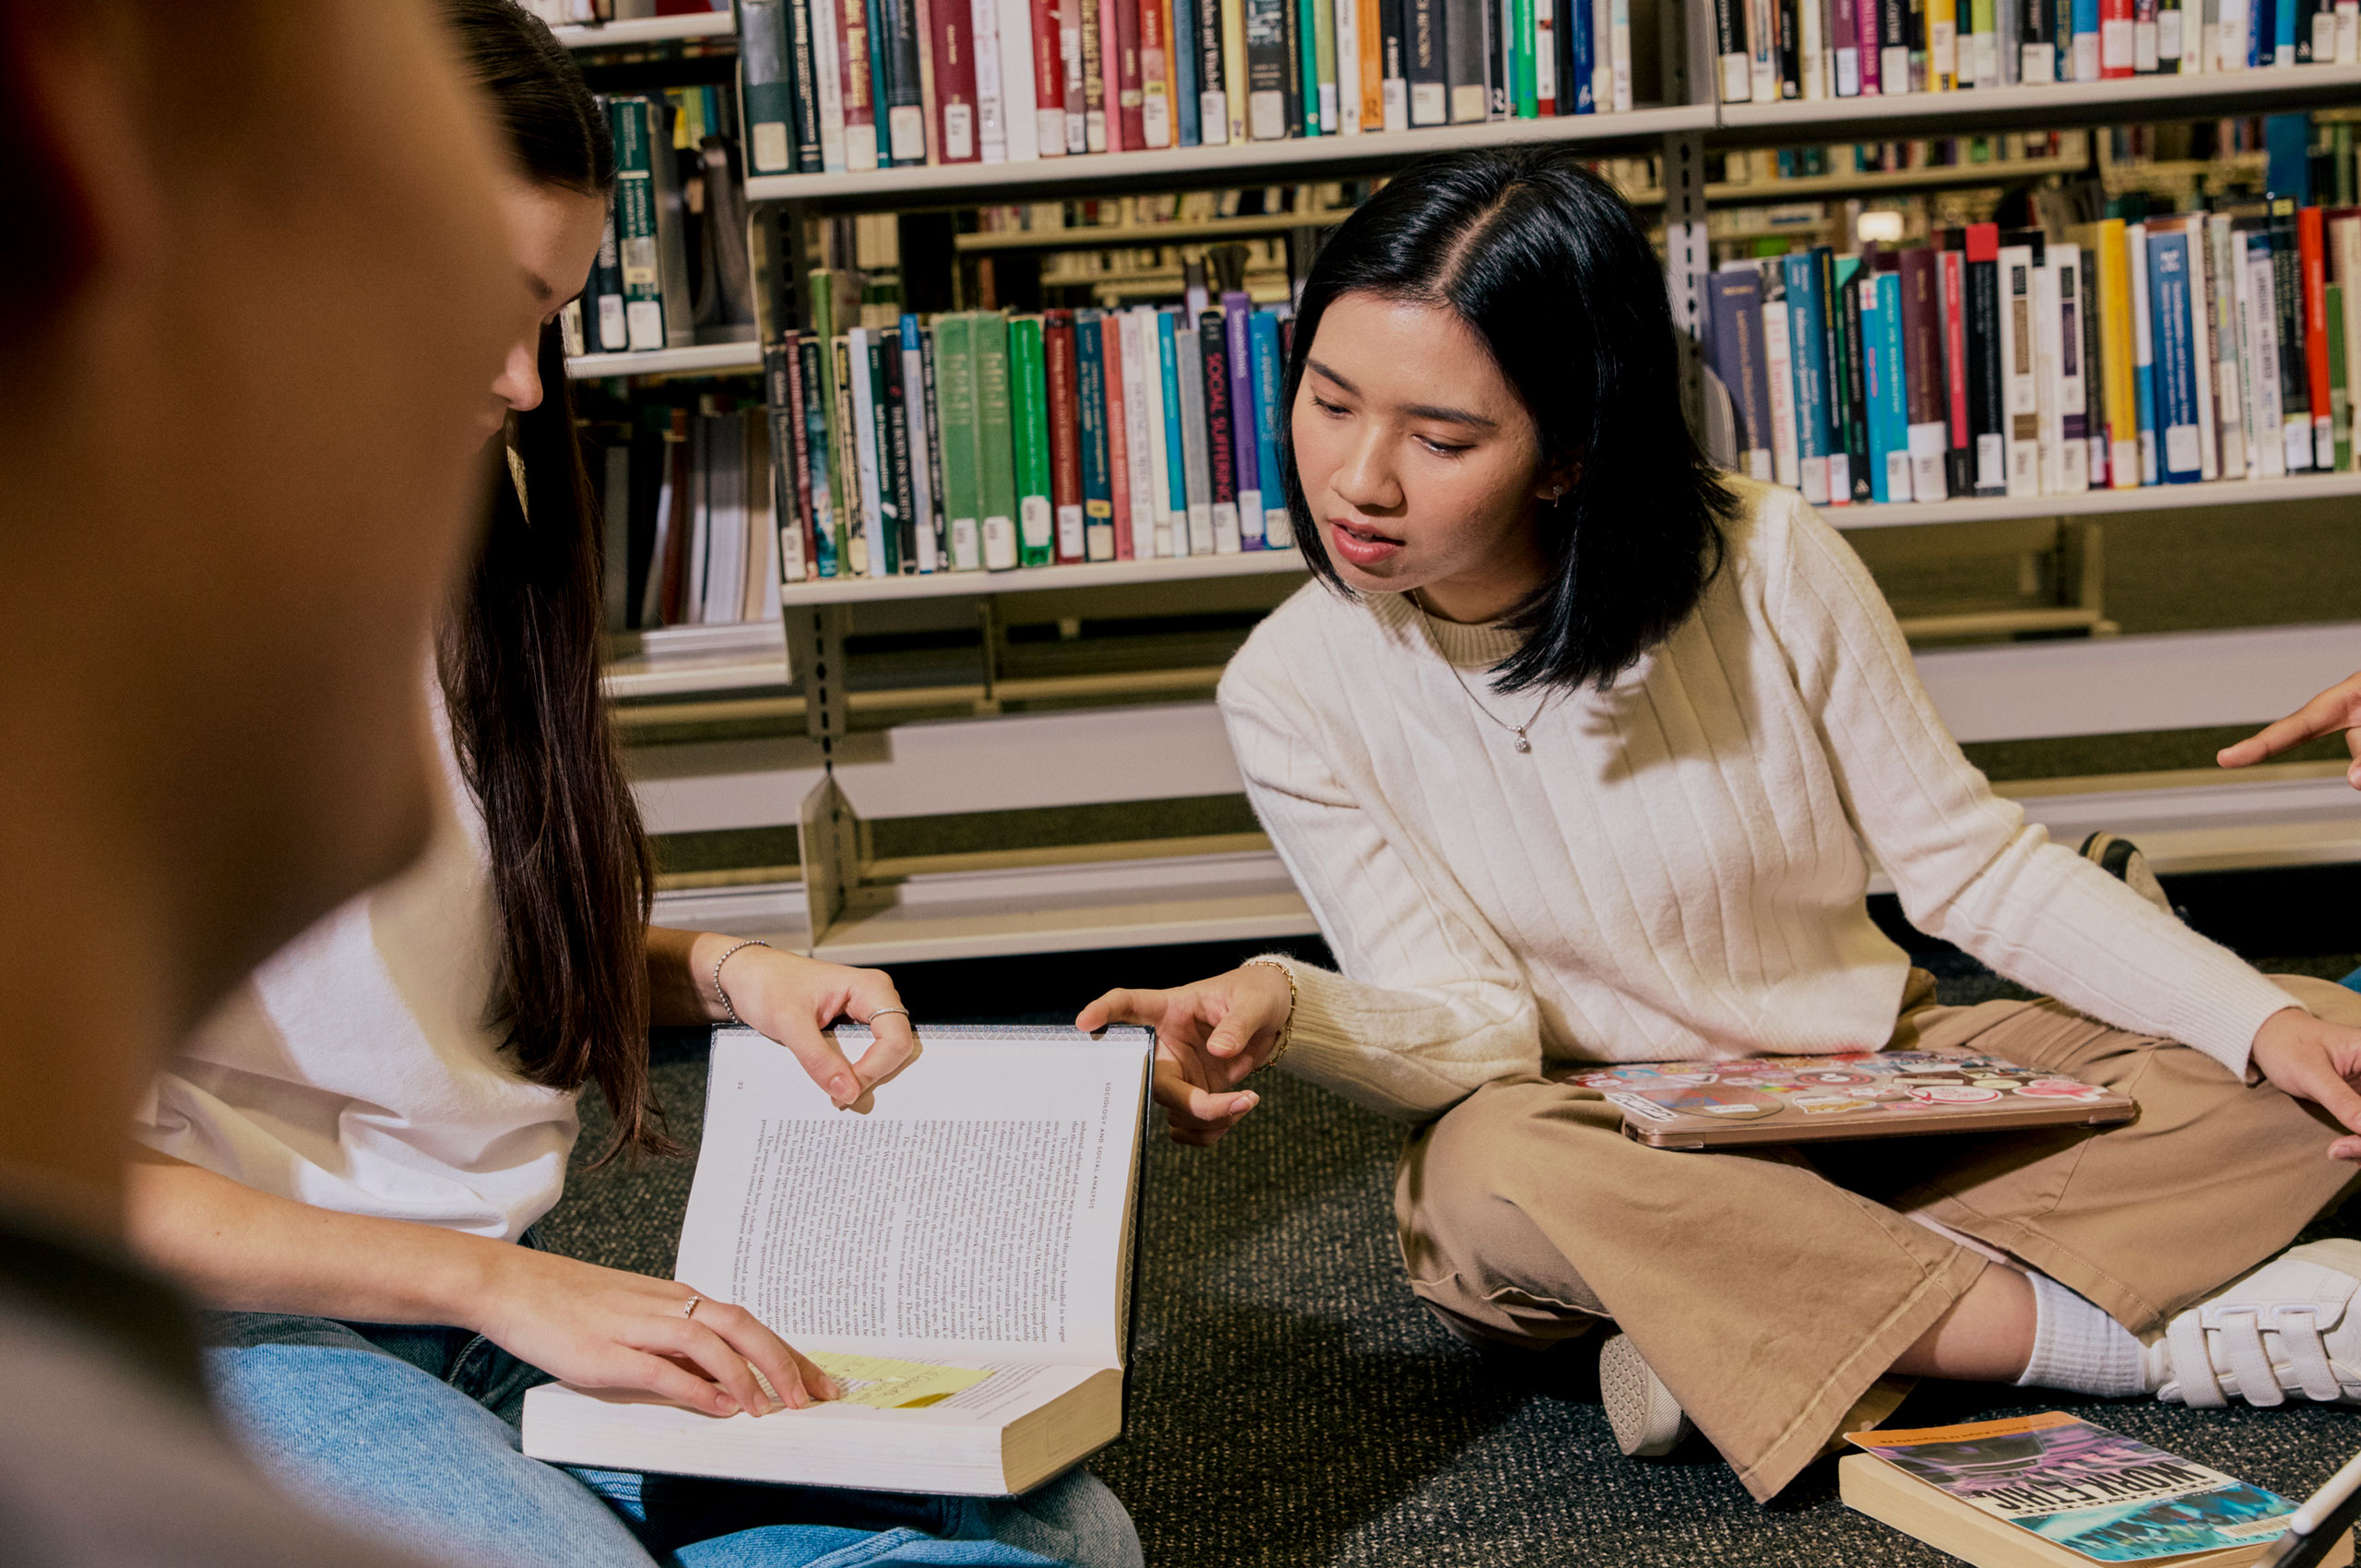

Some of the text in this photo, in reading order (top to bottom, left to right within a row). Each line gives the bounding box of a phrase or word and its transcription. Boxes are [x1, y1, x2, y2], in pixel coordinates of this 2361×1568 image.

[1231, 308, 1247, 379] Somatechnics
[1206, 352, 1233, 503] SOCIAL SUFFERING
[892, 406, 912, 522] THE BODY IN SOCIETY
[737, 1081, 744, 1090] 32
[1102, 1081, 1111, 1125] SOCIOLOGY
[827, 1120, 839, 1134] these
[924, 1120, 940, 1156] publication,
[971, 1120, 983, 1146] technical
[996, 1128, 1008, 1152] distance
[1077, 1121, 1088, 1149] industrial
[757, 1148, 770, 1172] position
[817, 1136, 833, 1168] procedures
[1037, 1140, 1050, 1160] history
[1058, 1149, 1067, 1164] term
[1072, 1151, 1083, 1170] sphere
[892, 1151, 908, 1181] arguments
[922, 1157, 932, 1171] value
[990, 1154, 1003, 1186] themselves
[757, 1174, 765, 1190] taken
[812, 1186, 823, 1203] based
[890, 1186, 901, 1202] about
[914, 1174, 929, 1204] judgments
[1033, 1182, 1041, 1199] social
[1051, 1166, 1064, 1198] 'value-free'
[1088, 1176, 1098, 1209] ANALYSIS
[752, 1192, 762, 1205] here
[959, 1177, 973, 1217] contradiction
[989, 1188, 997, 1203] from
[745, 1215, 757, 1234] clearly
[808, 1205, 819, 1219] and,
[887, 1206, 896, 1221] value
[1029, 1201, 1040, 1227] sciences.
[1048, 1211, 1056, 1226] been
[883, 1226, 893, 1251] freedom
[910, 1220, 921, 1242] choices
[953, 1231, 964, 1245] this,
[984, 1217, 993, 1235] moral
[1064, 1221, 1072, 1240] which
[1026, 1229, 1036, 1253] Weber's
[741, 1238, 752, 1273] value-based
[800, 1247, 812, 1275] possible,
[976, 1237, 990, 1275] implications
[948, 1266, 959, 1297] nowadays
[1042, 1258, 1051, 1281] various
[904, 1272, 914, 1299] present.
[1021, 1271, 1029, 1297] position
[877, 1286, 886, 1323] possibilities
[948, 1301, 957, 1339] increasingly
[1020, 1313, 1030, 1341] probably
[1039, 1312, 1048, 1342] emphases
[2076, 1461, 2209, 1498] WORK
[2012, 1480, 2218, 1516] SELLING THE
[2132, 1528, 2291, 1557] BEDER ARON
